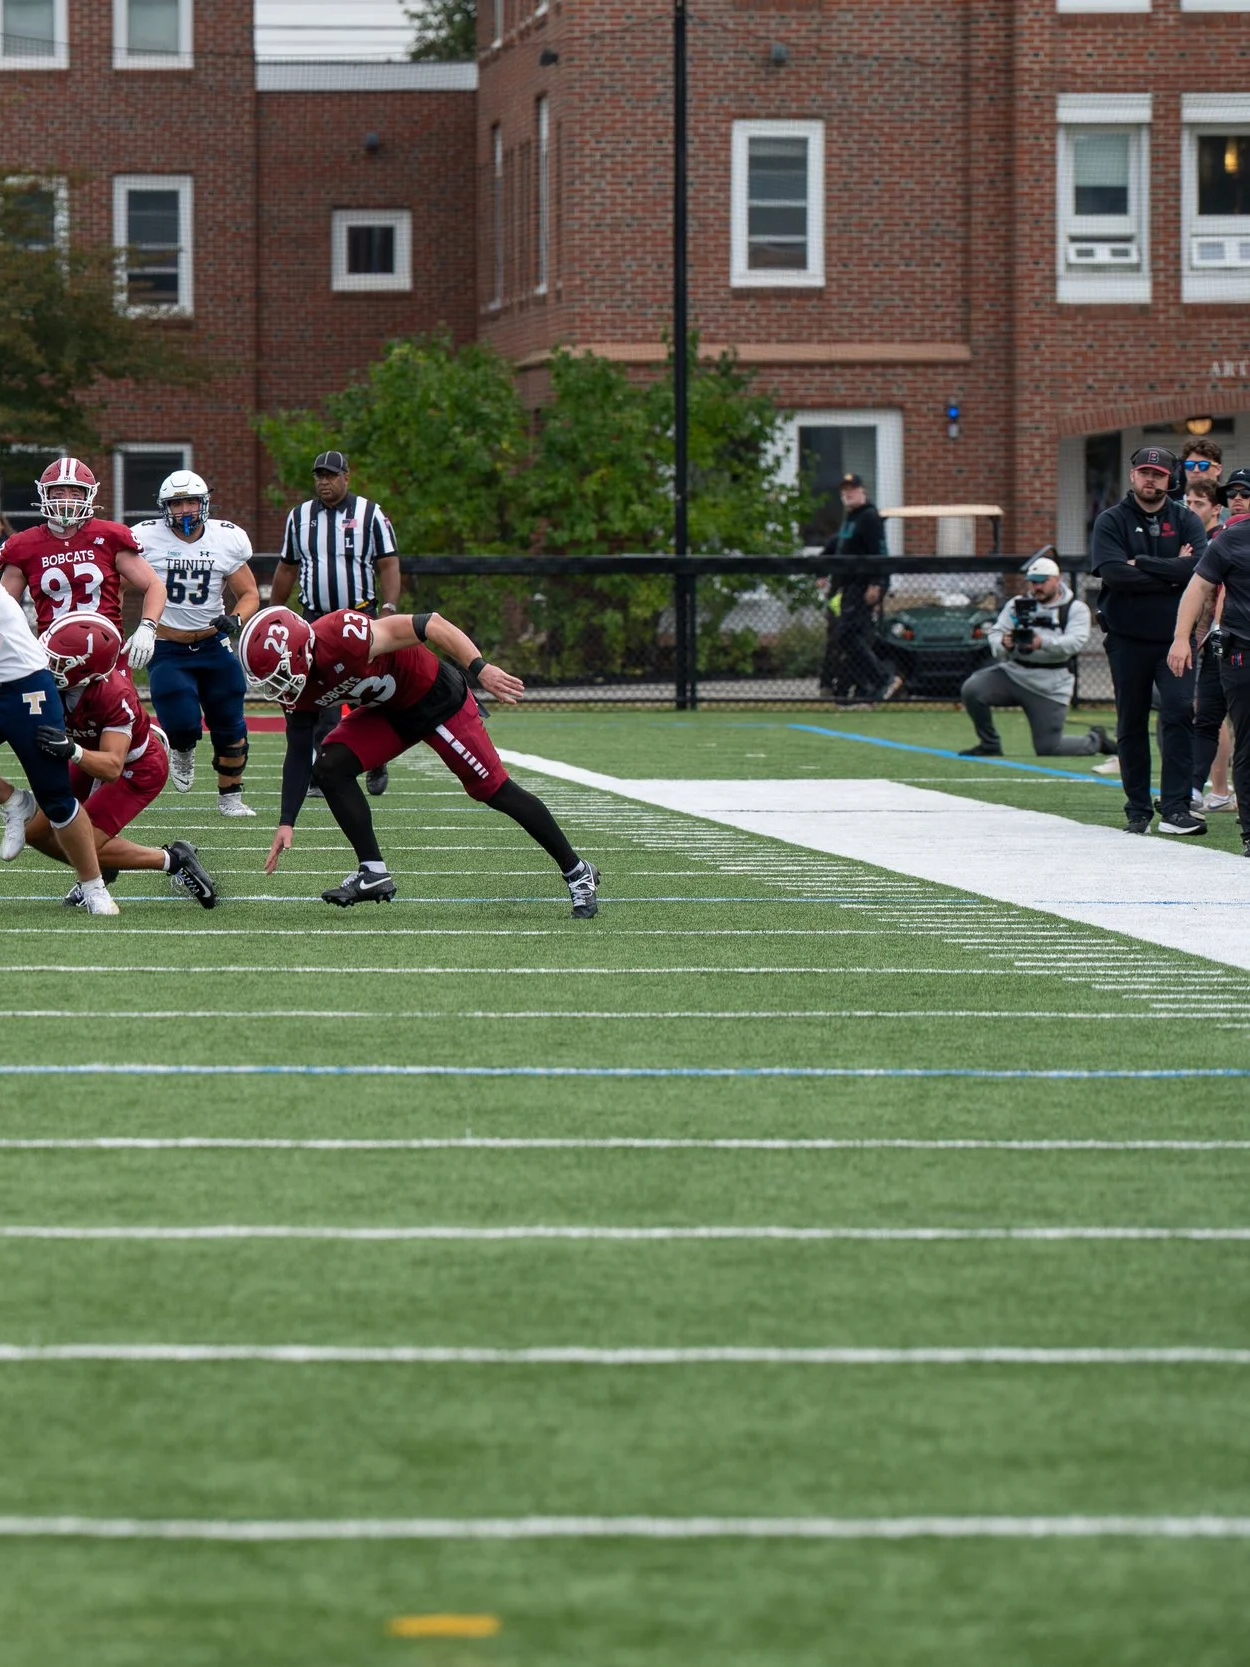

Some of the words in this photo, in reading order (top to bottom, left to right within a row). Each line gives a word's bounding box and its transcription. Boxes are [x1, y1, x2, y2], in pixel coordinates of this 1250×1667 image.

[345, 537, 354, 548] L
[41, 549, 95, 568] BOBCATS
[166, 558, 215, 571] TRINITY
[40, 562, 104, 620] 93
[165, 569, 211, 605] 63
[263, 624, 289, 655] 23
[342, 612, 369, 641] 23
[86, 632, 94, 654] 1
[22, 690, 46, 715] T
[314, 676, 362, 706] BOBCATS
